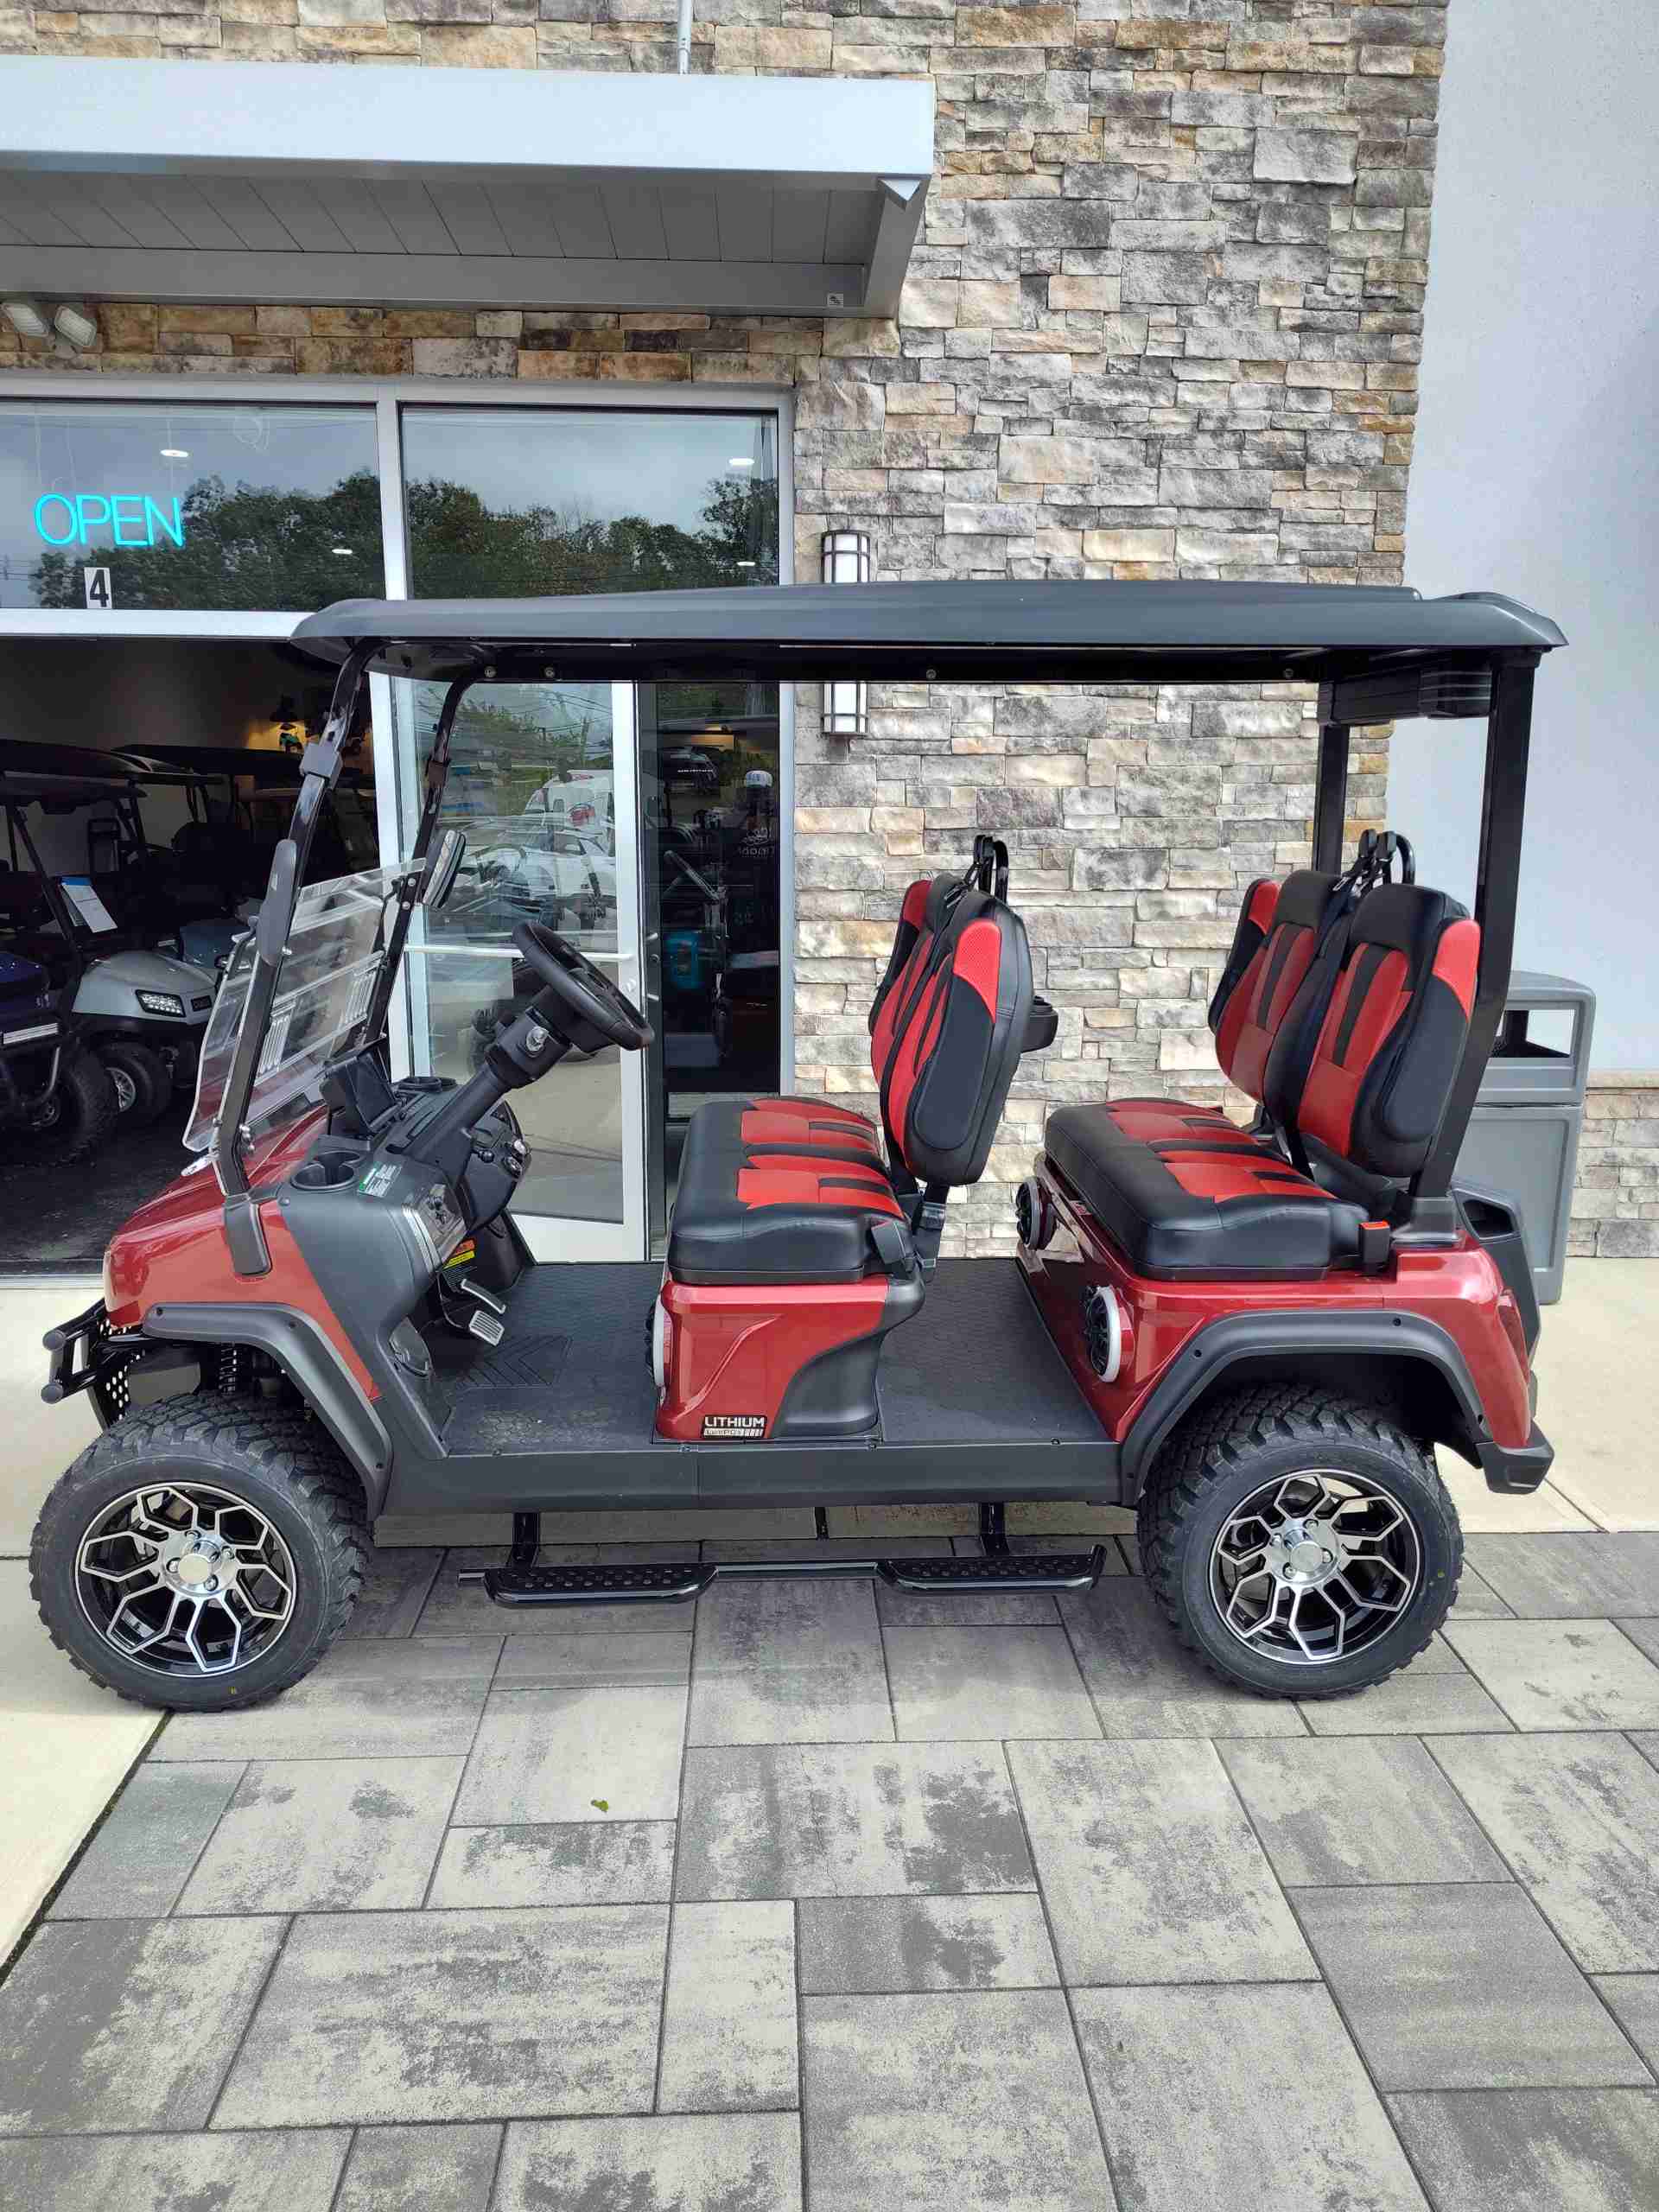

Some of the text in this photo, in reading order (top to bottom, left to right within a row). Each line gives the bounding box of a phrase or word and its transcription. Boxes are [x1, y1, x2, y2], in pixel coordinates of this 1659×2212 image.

[34, 493, 185, 547] OPEN
[89, 569, 110, 607] 4
[704, 1416, 765, 1427] LITHIUM
